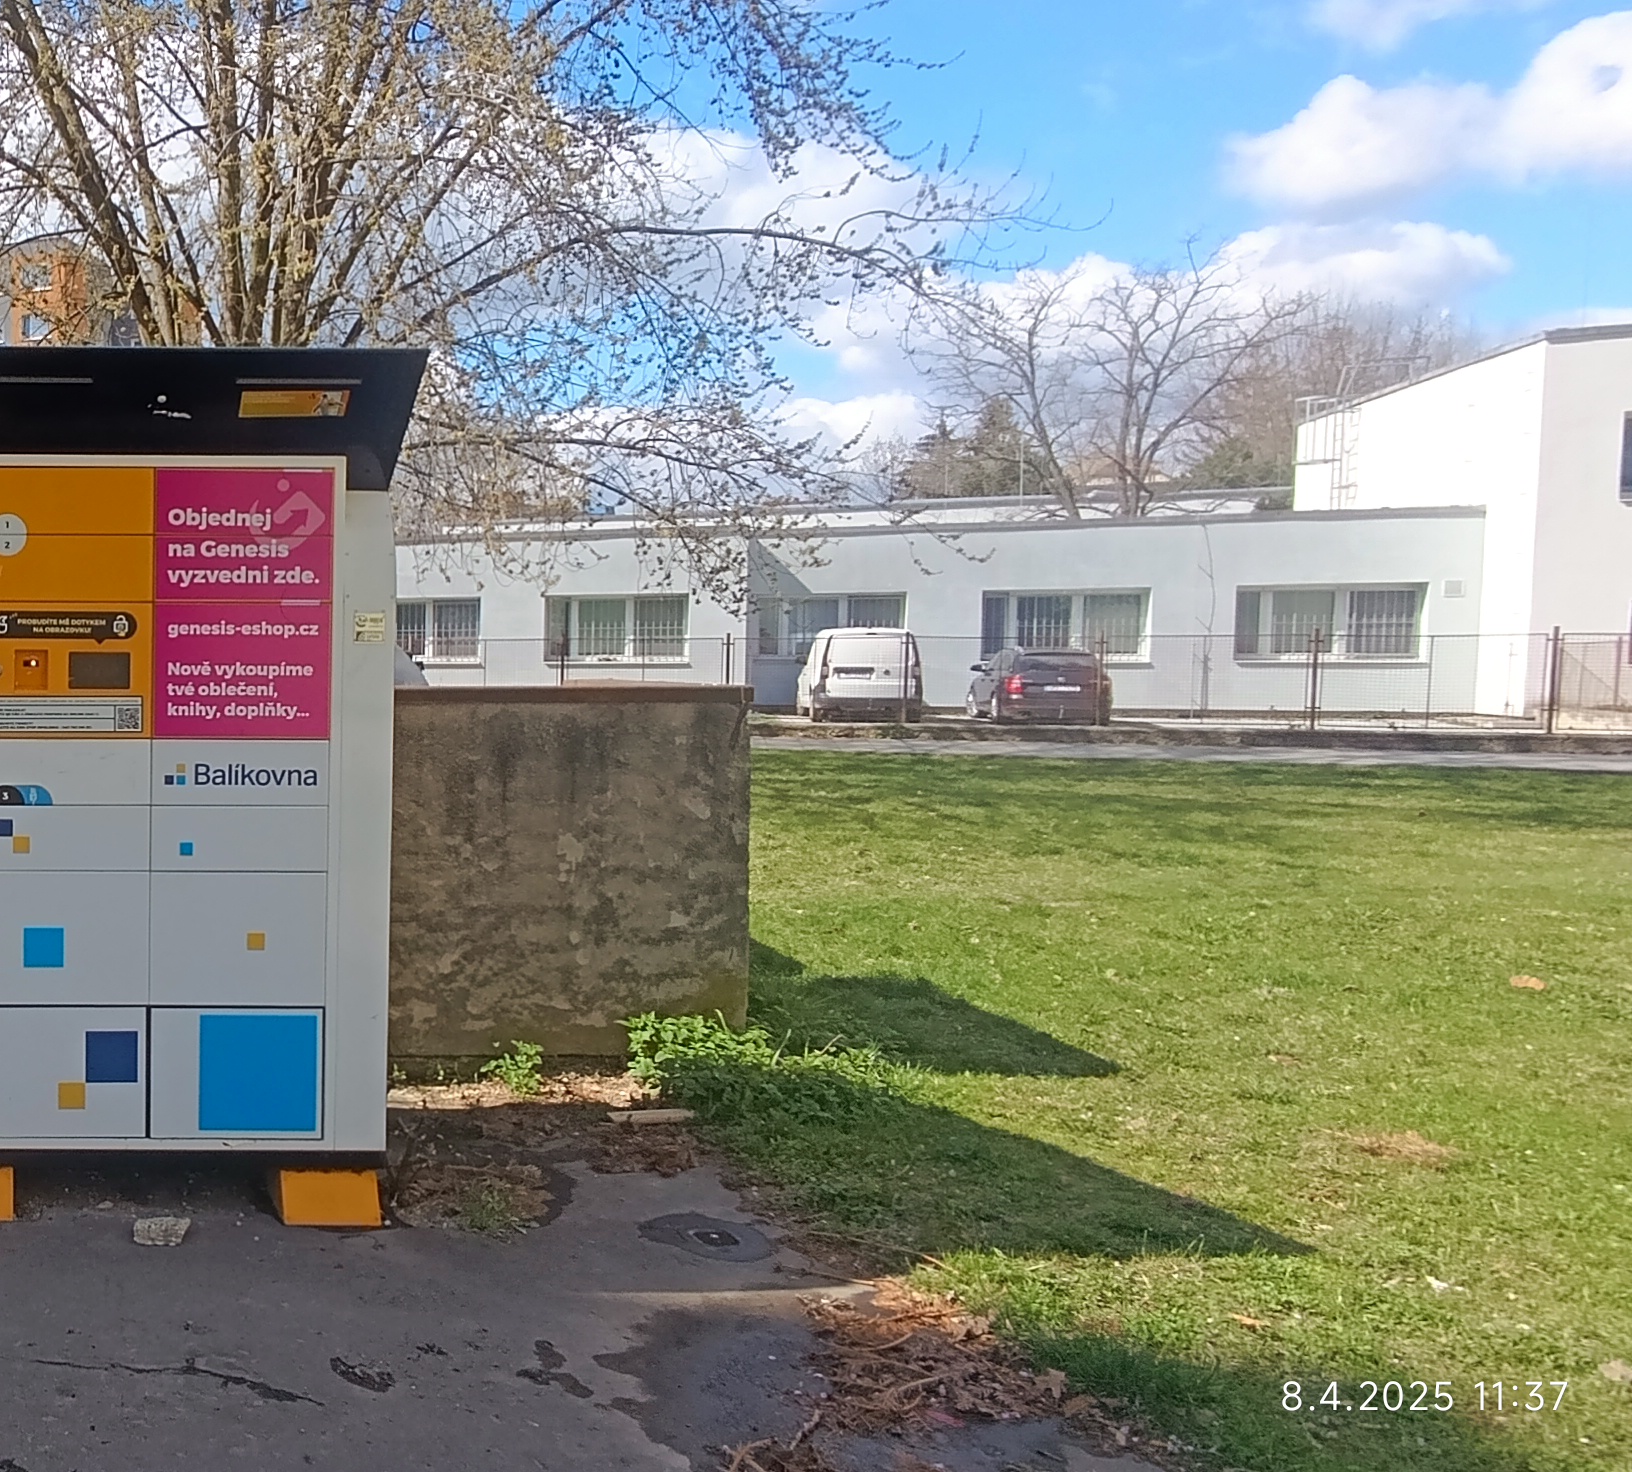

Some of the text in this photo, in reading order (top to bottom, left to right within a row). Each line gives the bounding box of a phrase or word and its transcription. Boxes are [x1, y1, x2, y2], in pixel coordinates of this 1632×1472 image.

[5, 521, 10, 529] 1
[167, 508, 272, 531] Objednej
[4, 541, 11, 550] 2
[167, 540, 290, 558] na Genesis
[167, 566, 320, 587] vyzvedni zde.
[71, 618, 107, 626] DOTYKEM
[167, 620, 319, 639] genesis-eshop.cz
[167, 660, 314, 681] Nově vykoupíme
[167, 681, 279, 700] tvé oblečení,
[167, 701, 310, 721] knihy, doplňky...
[194, 763, 318, 786] Balíkovna
[2, 791, 9, 800] 3
